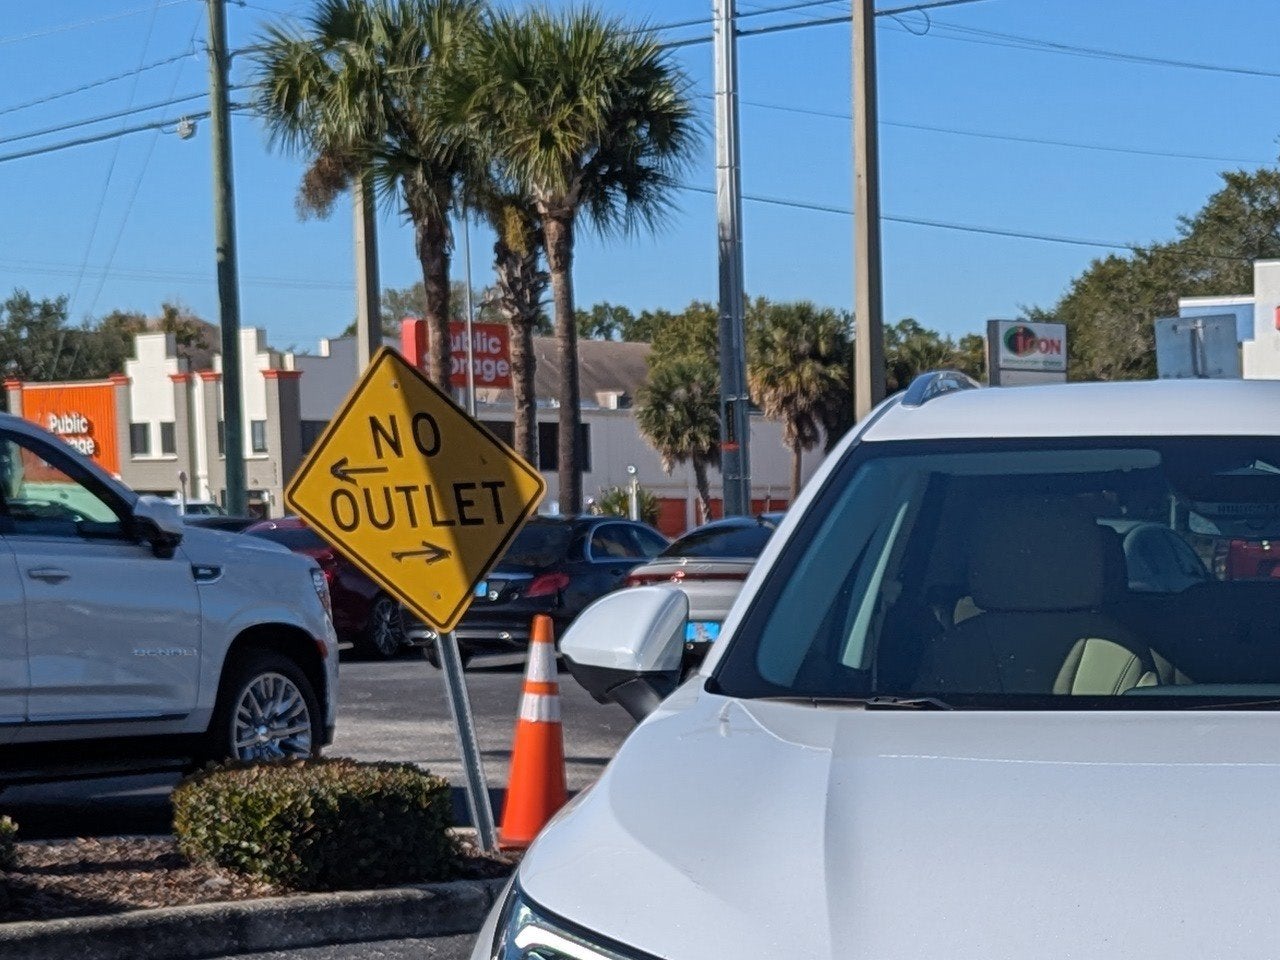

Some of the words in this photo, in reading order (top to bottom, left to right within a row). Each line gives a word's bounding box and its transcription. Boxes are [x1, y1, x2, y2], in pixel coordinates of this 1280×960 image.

[450, 330, 502, 355] ublic
[48, 411, 89, 434] Public
[368, 412, 442, 460] NO
[330, 481, 506, 533] OUTLET
